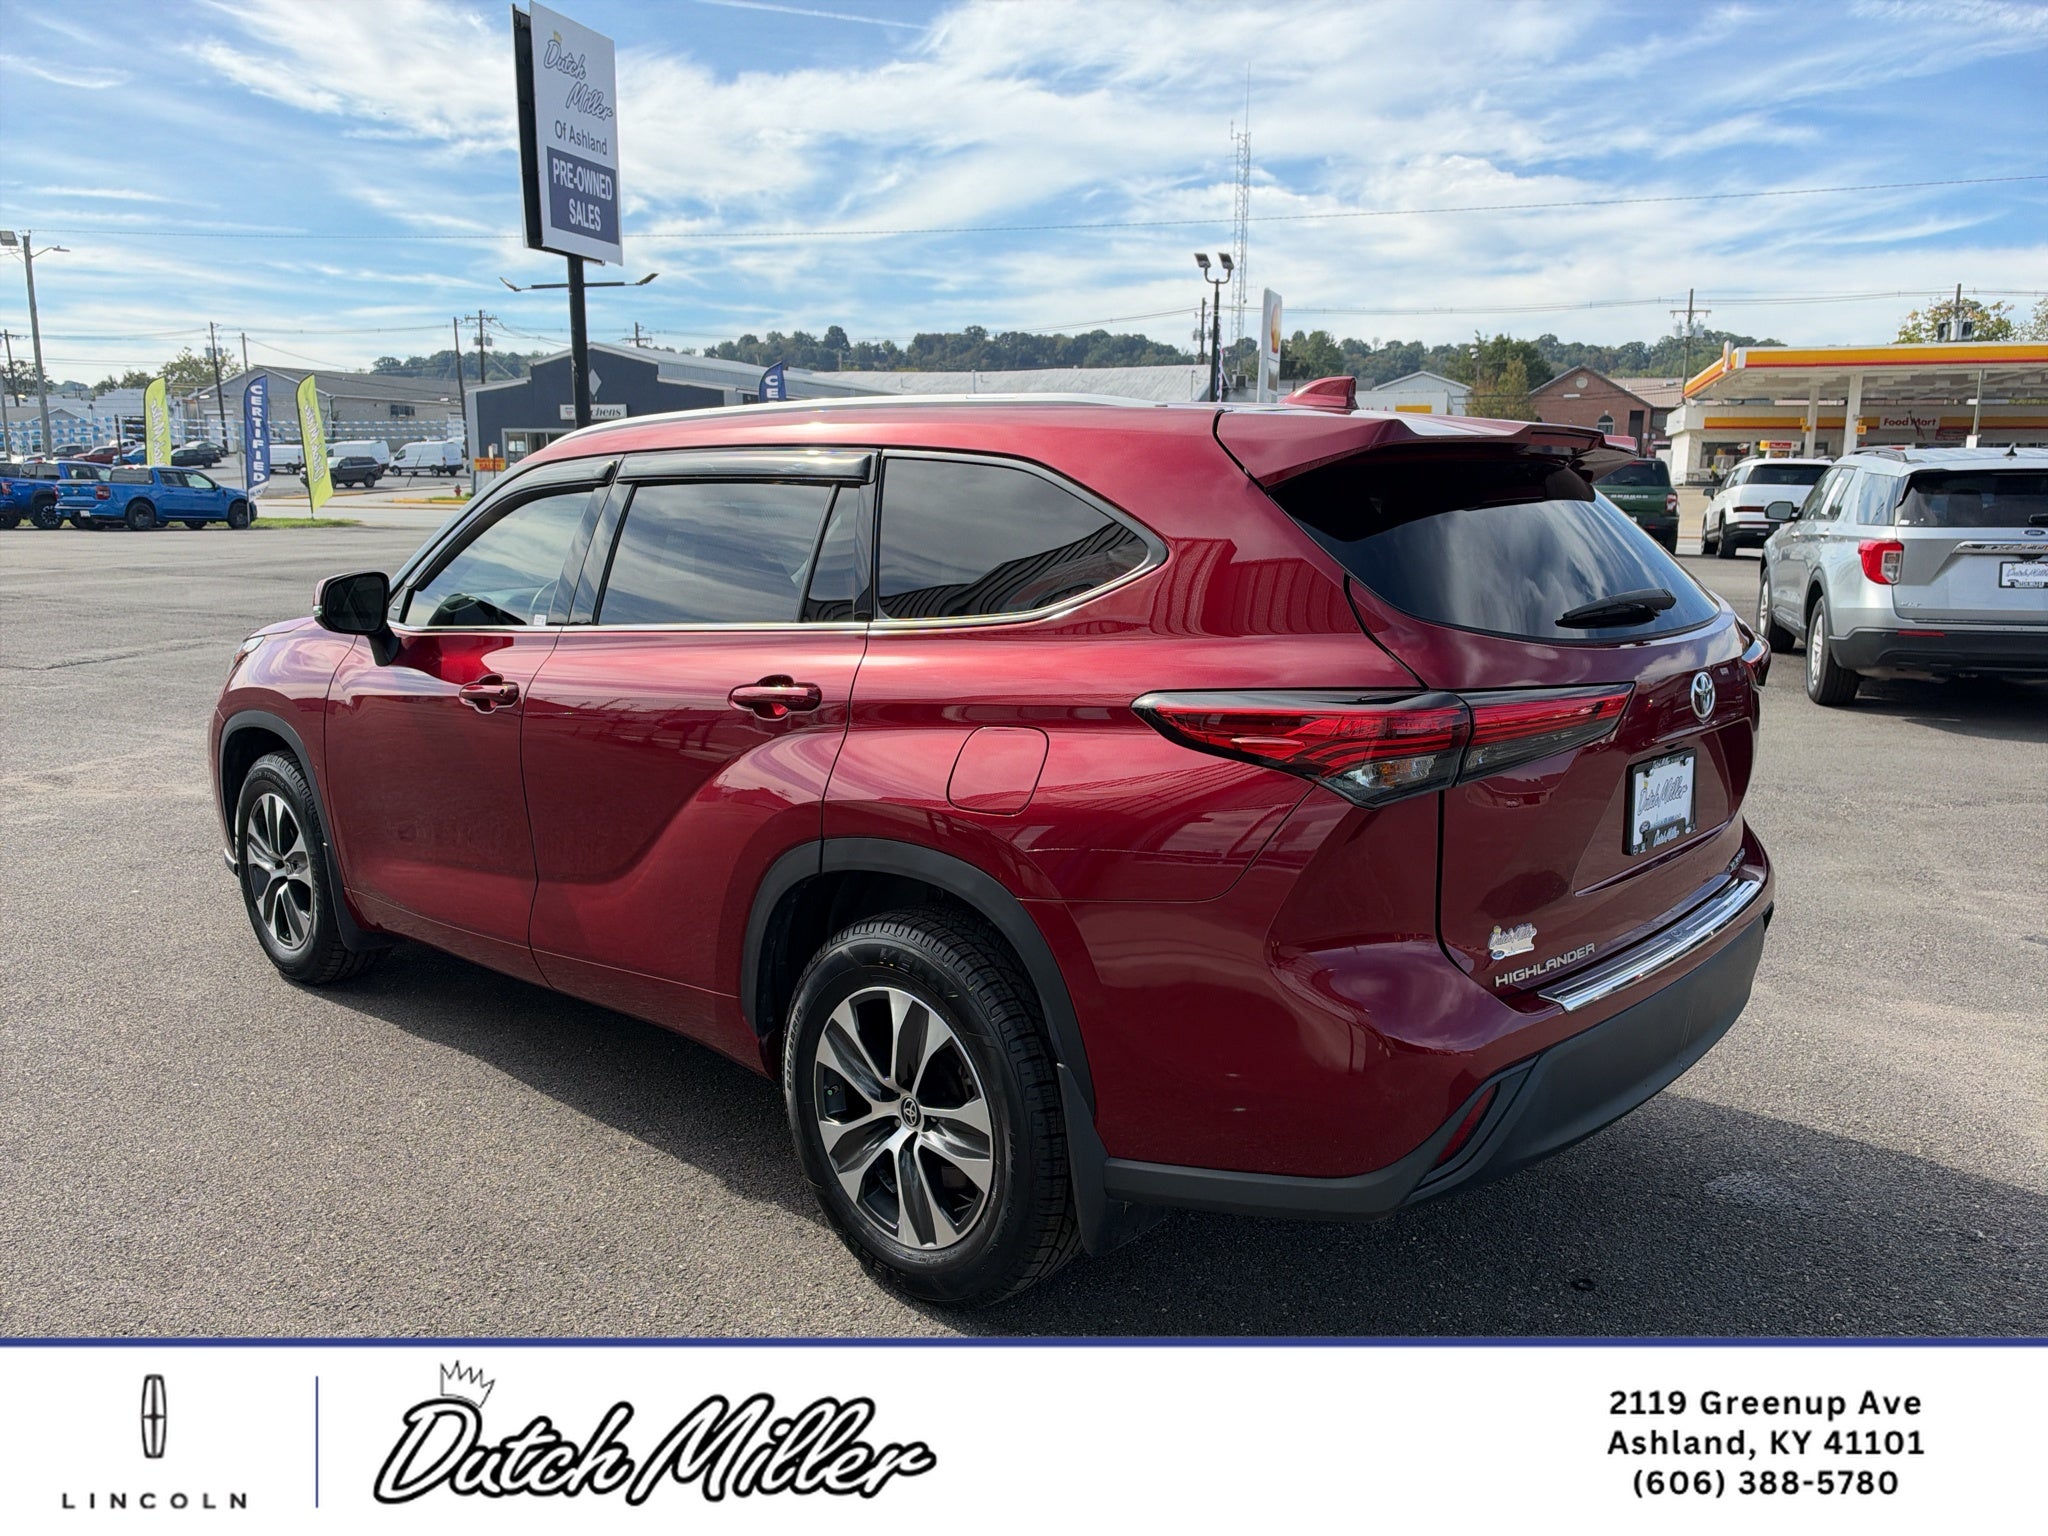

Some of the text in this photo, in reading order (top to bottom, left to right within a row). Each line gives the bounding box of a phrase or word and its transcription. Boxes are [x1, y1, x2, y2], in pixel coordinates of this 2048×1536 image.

[544, 40, 586, 80] Dutch
[565, 81, 614, 121] Miller
[554, 120, 608, 155] Of Ashland
[552, 157, 613, 201] PRE-OWNED
[568, 198, 602, 232] SALES
[249, 384, 266, 482] CERTIFIED
[1884, 416, 1909, 426] Food
[1495, 943, 1596, 988] HIGHLANDER
